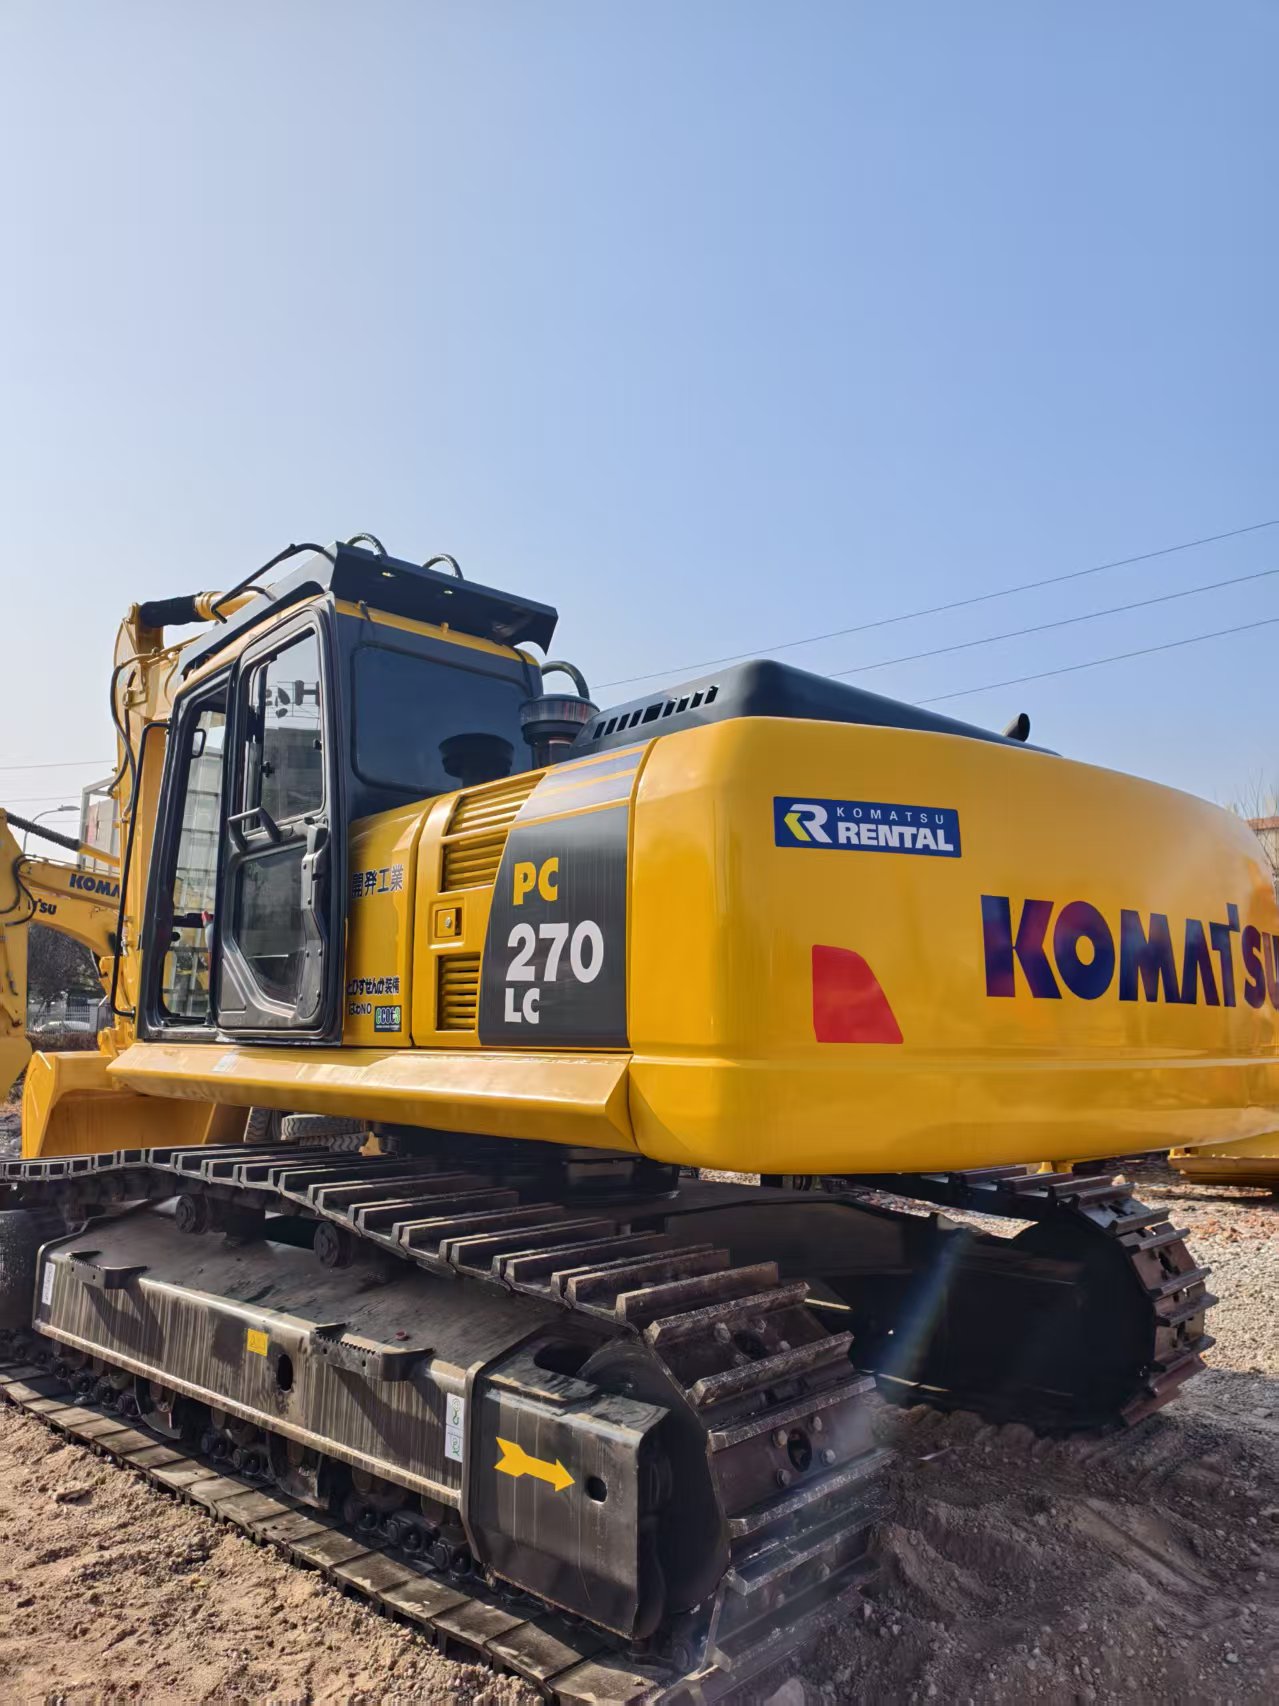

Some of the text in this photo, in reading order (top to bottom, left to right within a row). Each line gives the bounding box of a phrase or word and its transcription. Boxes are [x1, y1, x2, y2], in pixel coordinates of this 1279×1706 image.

[836, 807, 944, 824] KOMATSU
[837, 821, 954, 851] RENTAL
[513, 857, 559, 905] PC
[505, 920, 604, 983] 270
[980, 894, 1279, 1011] KOMATSU
[504, 988, 540, 1024] LC
